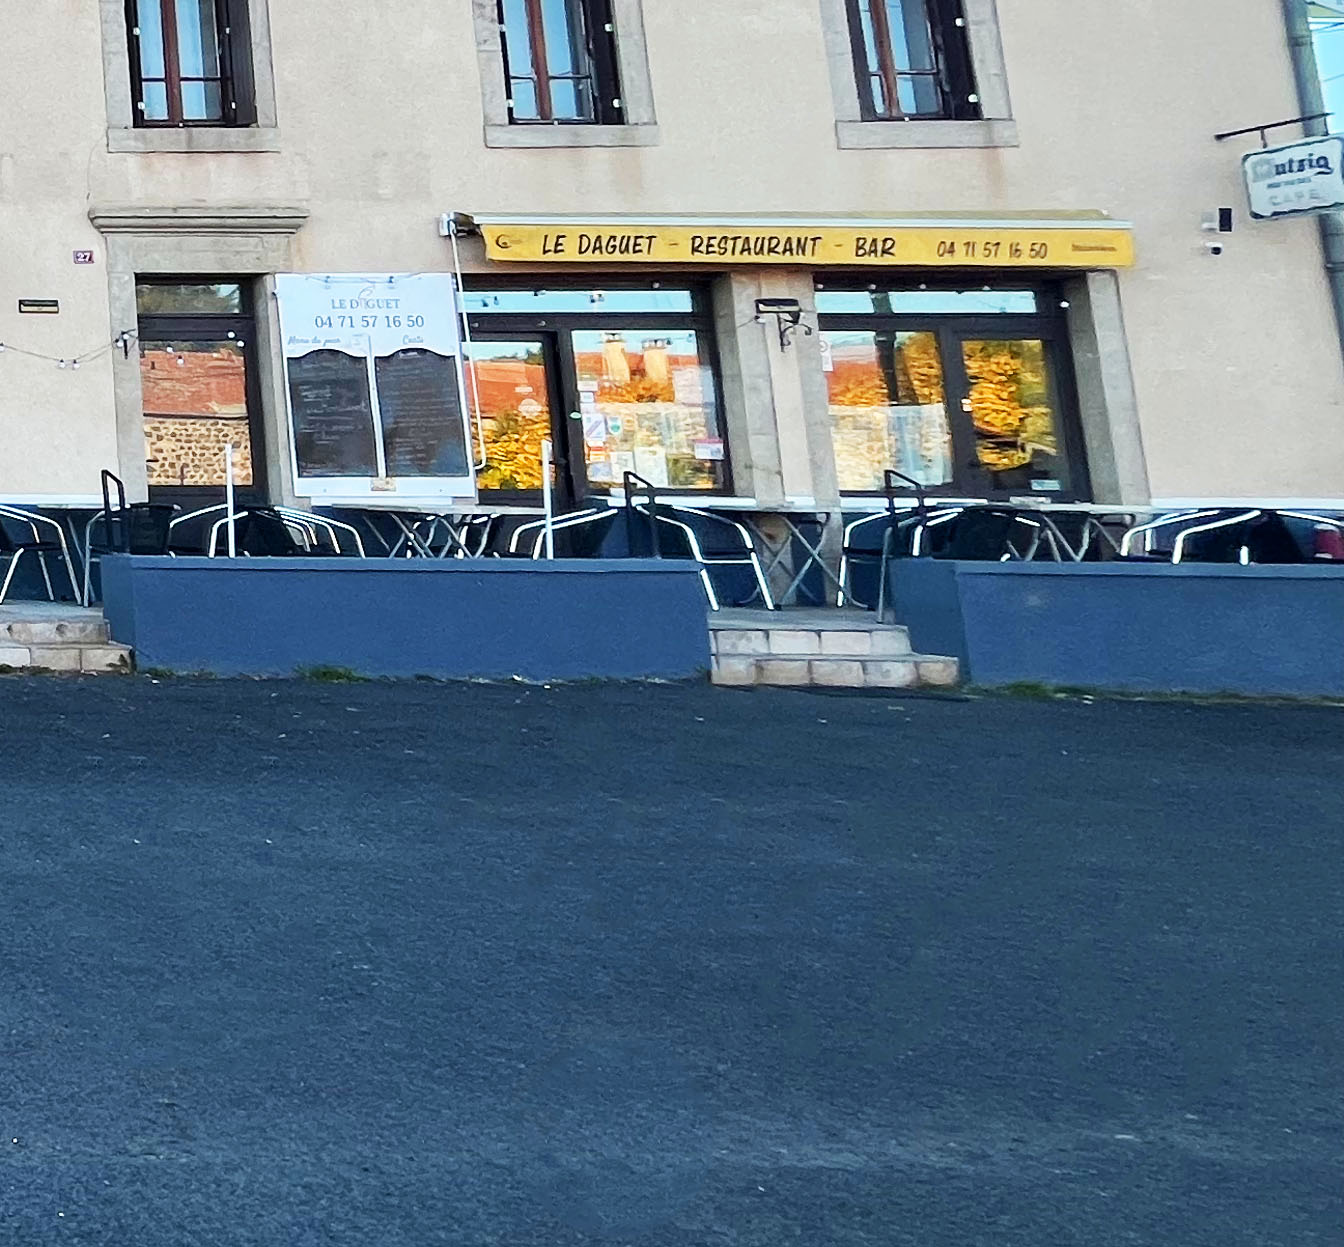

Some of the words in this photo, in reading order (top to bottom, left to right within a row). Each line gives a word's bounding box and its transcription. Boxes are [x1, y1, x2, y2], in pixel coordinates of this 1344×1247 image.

[542, 234, 567, 255] LE
[578, 233, 657, 255] DAGUET
[690, 235, 823, 257] RESTAURANT
[854, 236, 896, 258] BAR
[937, 240, 956, 258] 04
[963, 241, 976, 258] 71
[982, 241, 1001, 258] 57
[1008, 242, 1022, 258] 16
[1028, 242, 1048, 259] 50
[76, 252, 91, 262] 27
[331, 298, 347, 310] LE
[314, 315, 333, 328] 04
[337, 315, 355, 328] 71
[361, 315, 378, 328] 57
[384, 315, 402, 328] 16
[407, 314, 425, 328] 50
